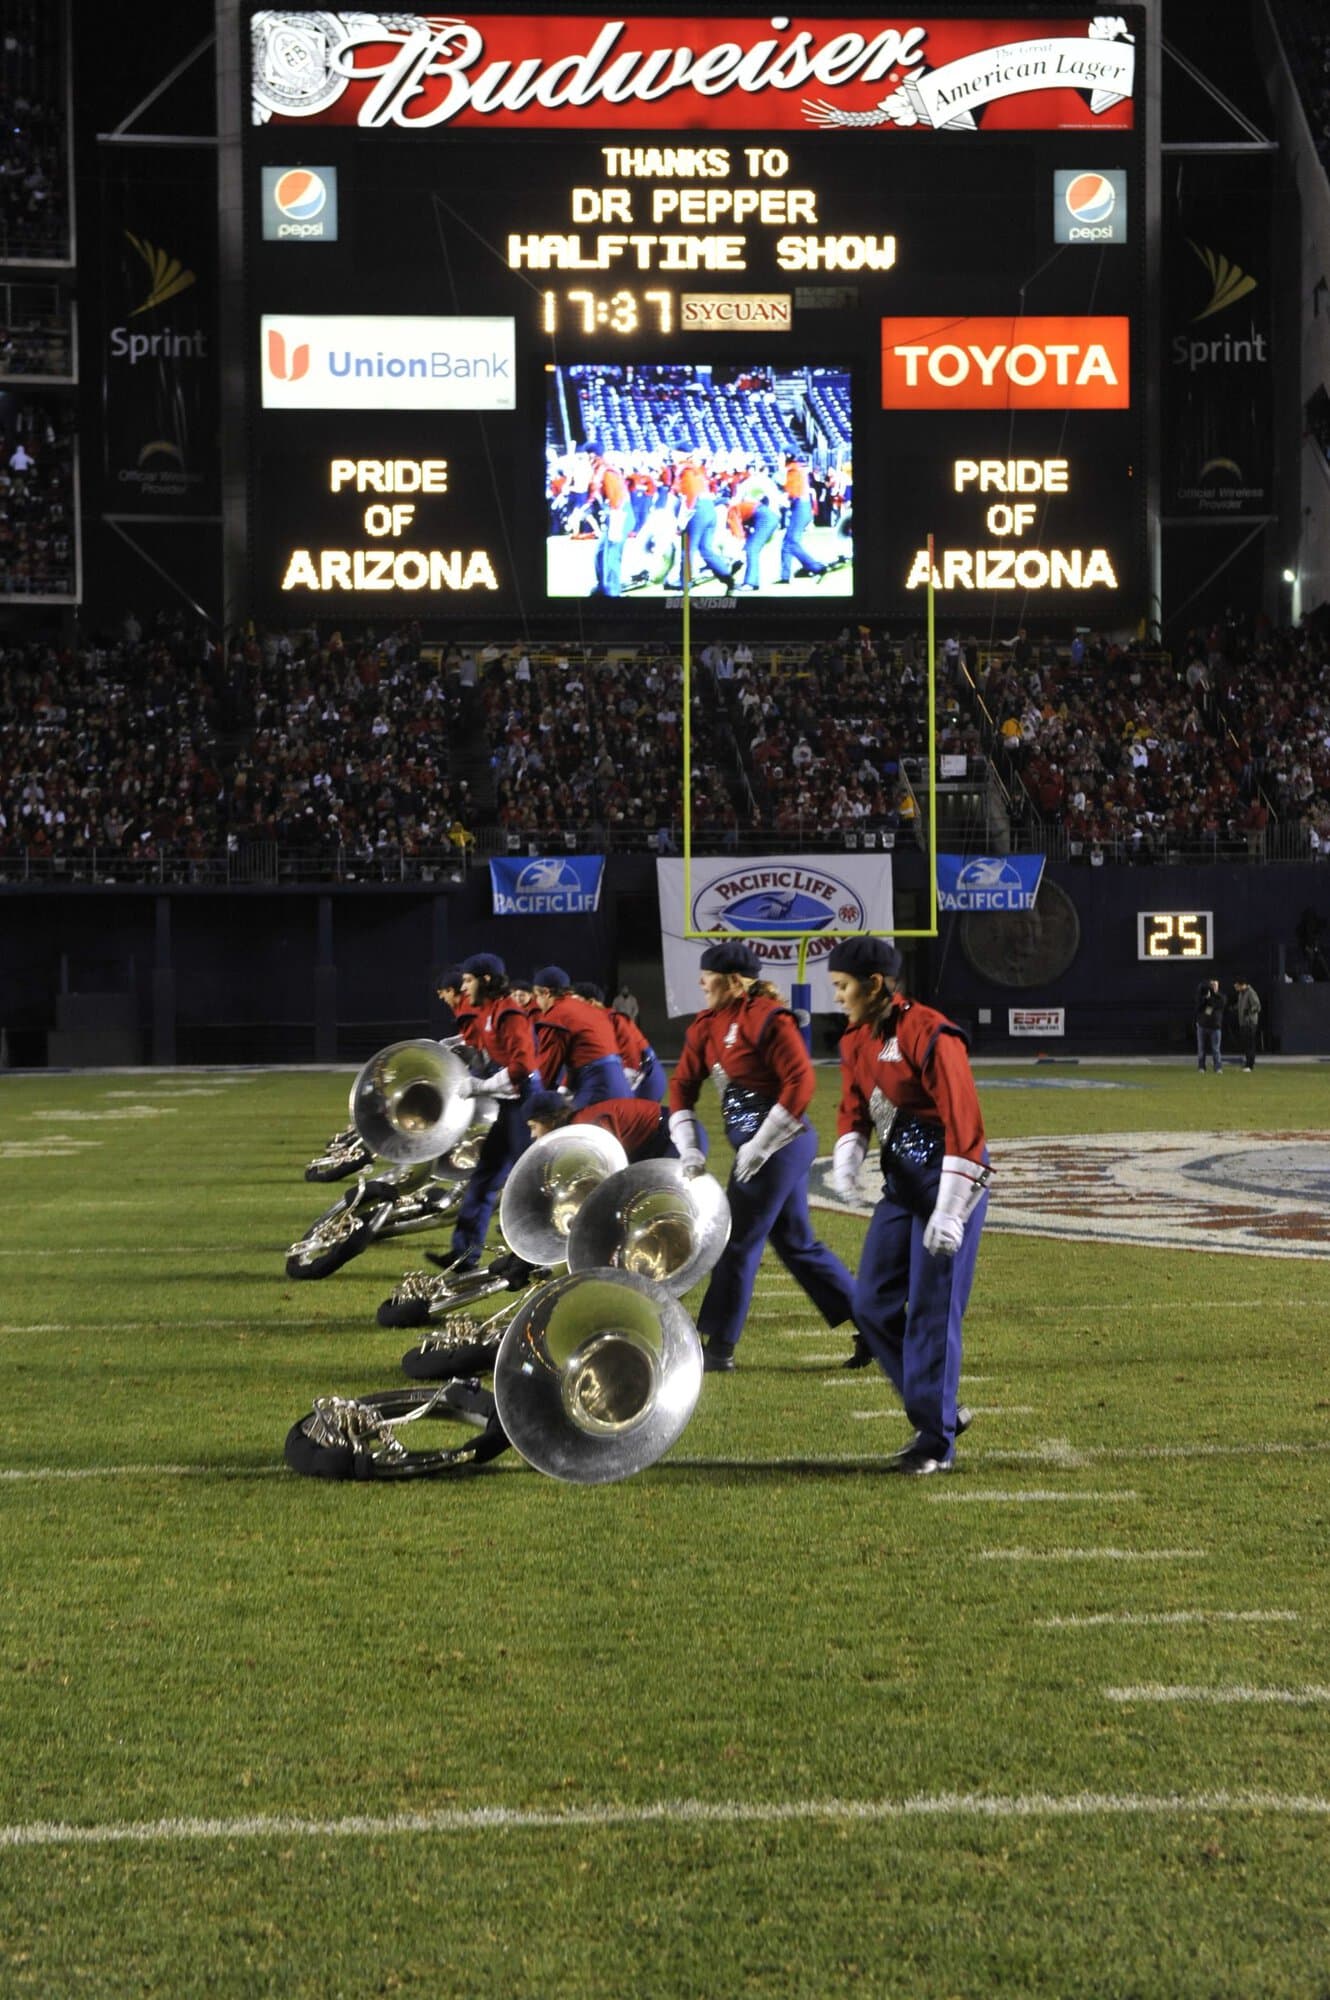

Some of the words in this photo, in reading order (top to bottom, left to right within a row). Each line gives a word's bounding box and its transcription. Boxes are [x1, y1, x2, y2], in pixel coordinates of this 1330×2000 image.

[332, 16, 926, 127] Budweiser
[935, 60, 1048, 112] American
[1056, 54, 1127, 81] Lager
[602, 147, 730, 177] THANKS
[744, 148, 789, 177] TO
[572, 188, 633, 223] DR
[653, 189, 819, 224] PEPPER
[278, 221, 323, 238] pepsi
[1069, 225, 1112, 241] pepsi
[508, 235, 746, 270] HALFTIME
[777, 236, 896, 270] SHOW
[544, 291, 672, 333] 17:37
[685, 303, 789, 321] SYCUAN
[110, 326, 207, 365] Sprint
[1172, 333, 1267, 371] Sprint
[894, 344, 1118, 386] TOYOTA
[331, 460, 448, 493] PRIDE
[954, 460, 1068, 493] PRIDE
[364, 505, 415, 536] OF
[986, 504, 1037, 536] OF
[281, 551, 499, 591] ARIZONA
[906, 550, 1118, 589] ARIZONA
[1150, 911, 1202, 956] 25
[1013, 1012, 1059, 1024] ESPN
